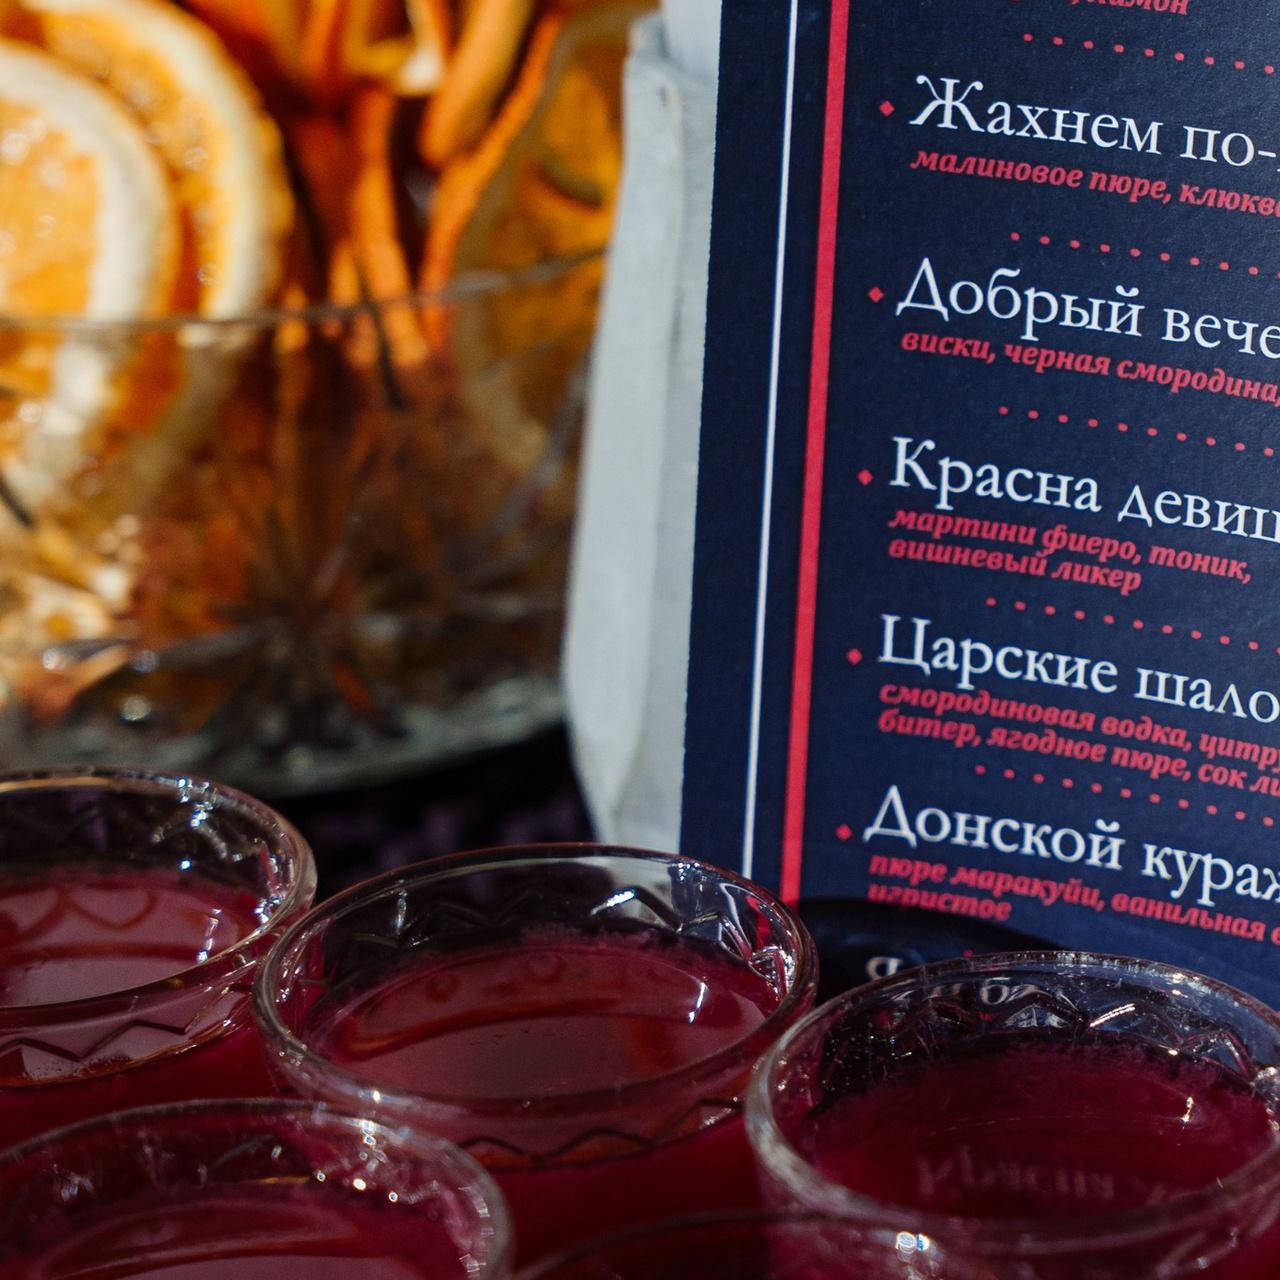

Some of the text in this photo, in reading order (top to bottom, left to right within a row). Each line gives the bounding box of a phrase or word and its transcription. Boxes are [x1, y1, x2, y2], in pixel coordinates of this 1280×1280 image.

[911, 75, 1164, 155] Жахнем
[910, 151, 1083, 188] малиновое
[1089, 172, 1171, 204] пюре,
[896, 257, 1146, 341] Добрый
[901, 332, 995, 363] виски,
[1005, 344, 1110, 375] черная
[890, 437, 1102, 512] Красна
[889, 510, 1250, 583] мартини фиеро, тоник,
[889, 539, 1141, 596] вишневый ликер
[879, 615, 1118, 692] Царские
[878, 708, 981, 747] битер,
[987, 728, 1106, 762] ягодное
[1111, 747, 1191, 780] пюре,
[1198, 764, 1247, 789] сок
[880, 685, 1095, 731] смородиновая
[1101, 716, 1192, 751] водка,
[864, 785, 1126, 870] Донской
[868, 884, 1011, 920] игристое
[869, 855, 947, 885] пюре
[951, 867, 1105, 910] маракуйи,
[1111, 894, 1266, 941] ванильная
